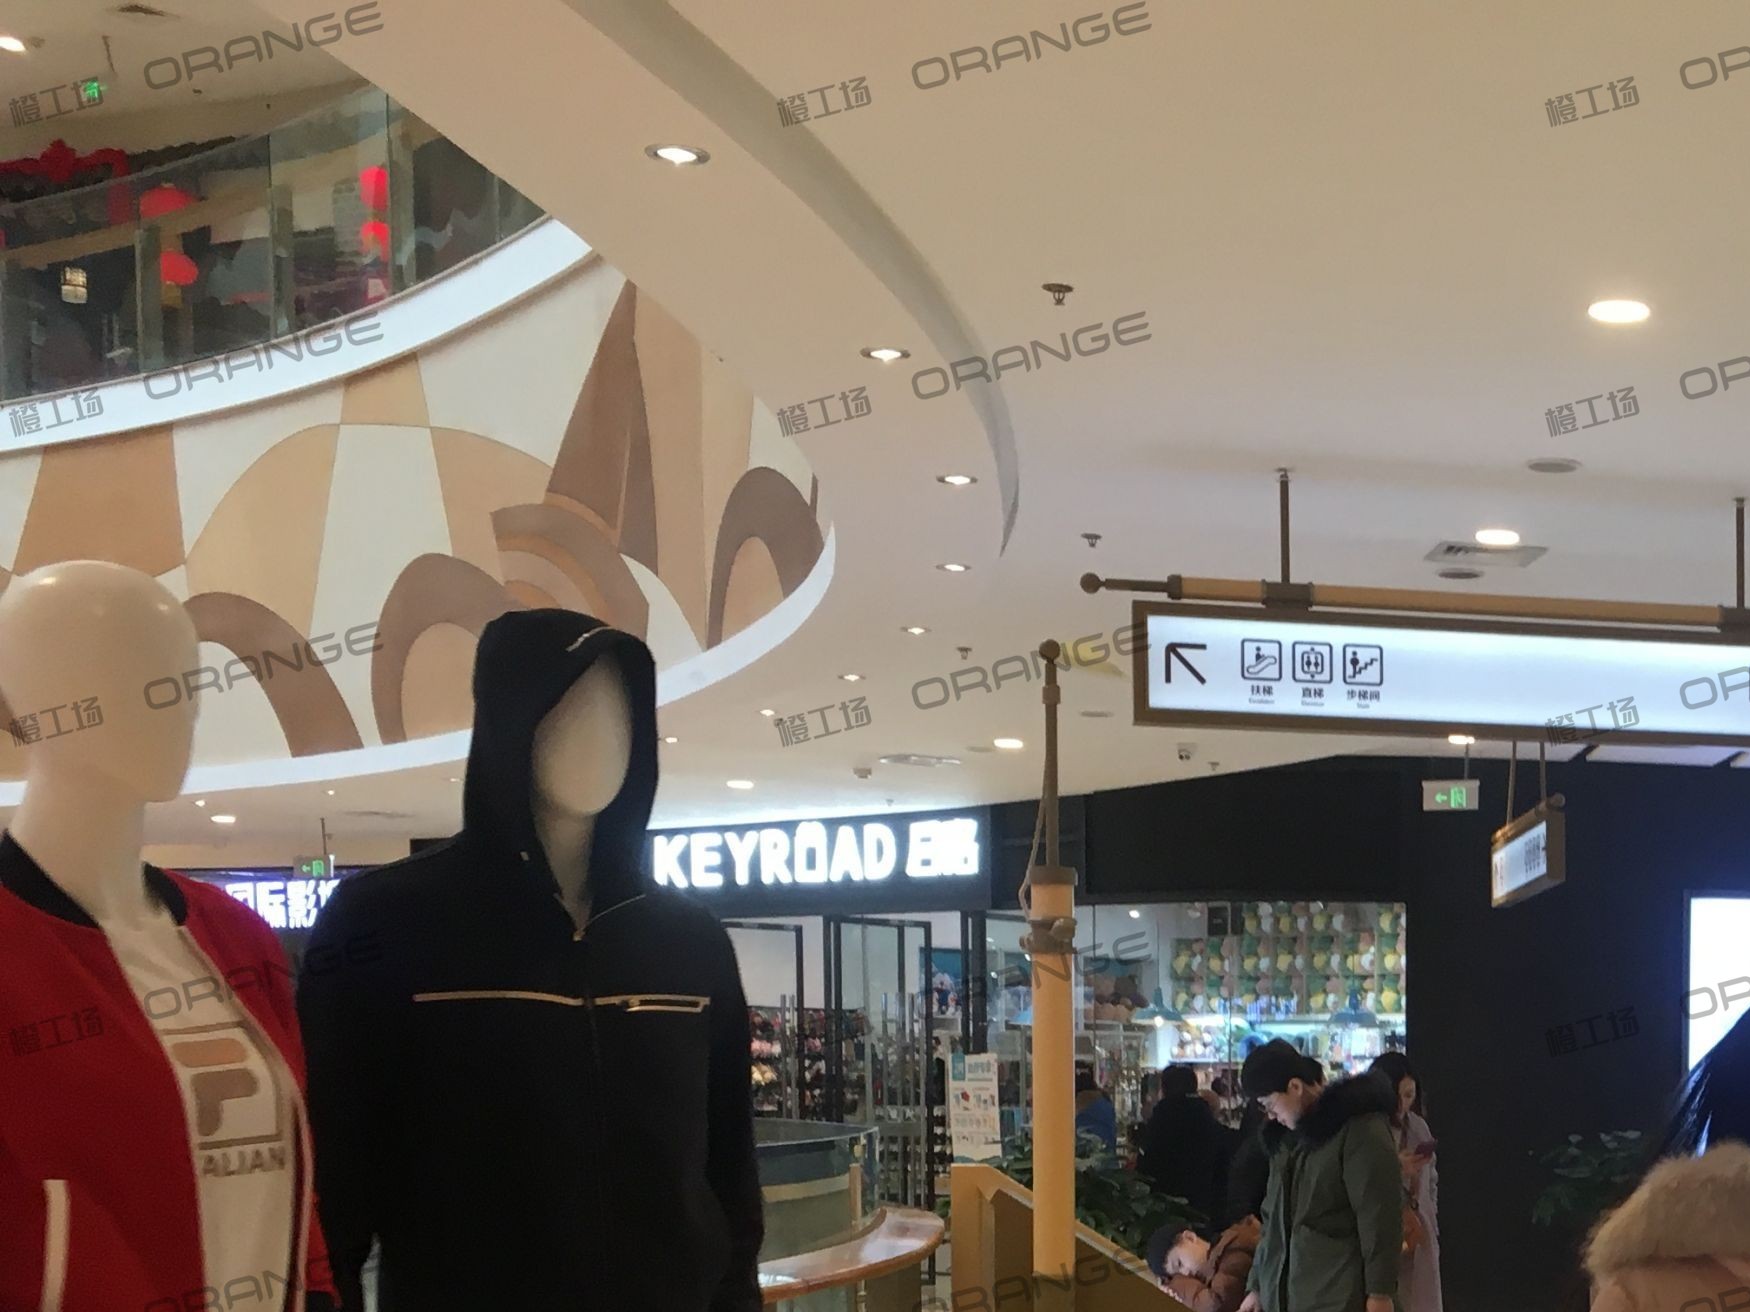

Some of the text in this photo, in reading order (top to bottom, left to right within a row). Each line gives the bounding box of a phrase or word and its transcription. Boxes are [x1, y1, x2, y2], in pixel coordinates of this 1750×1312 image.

[1250, 684, 1273, 697] 扶梯
[1301, 687, 1324, 699] 直梯
[652, 820, 897, 889] KEYROAD
[202, 1145, 286, 1178] ALIAN
